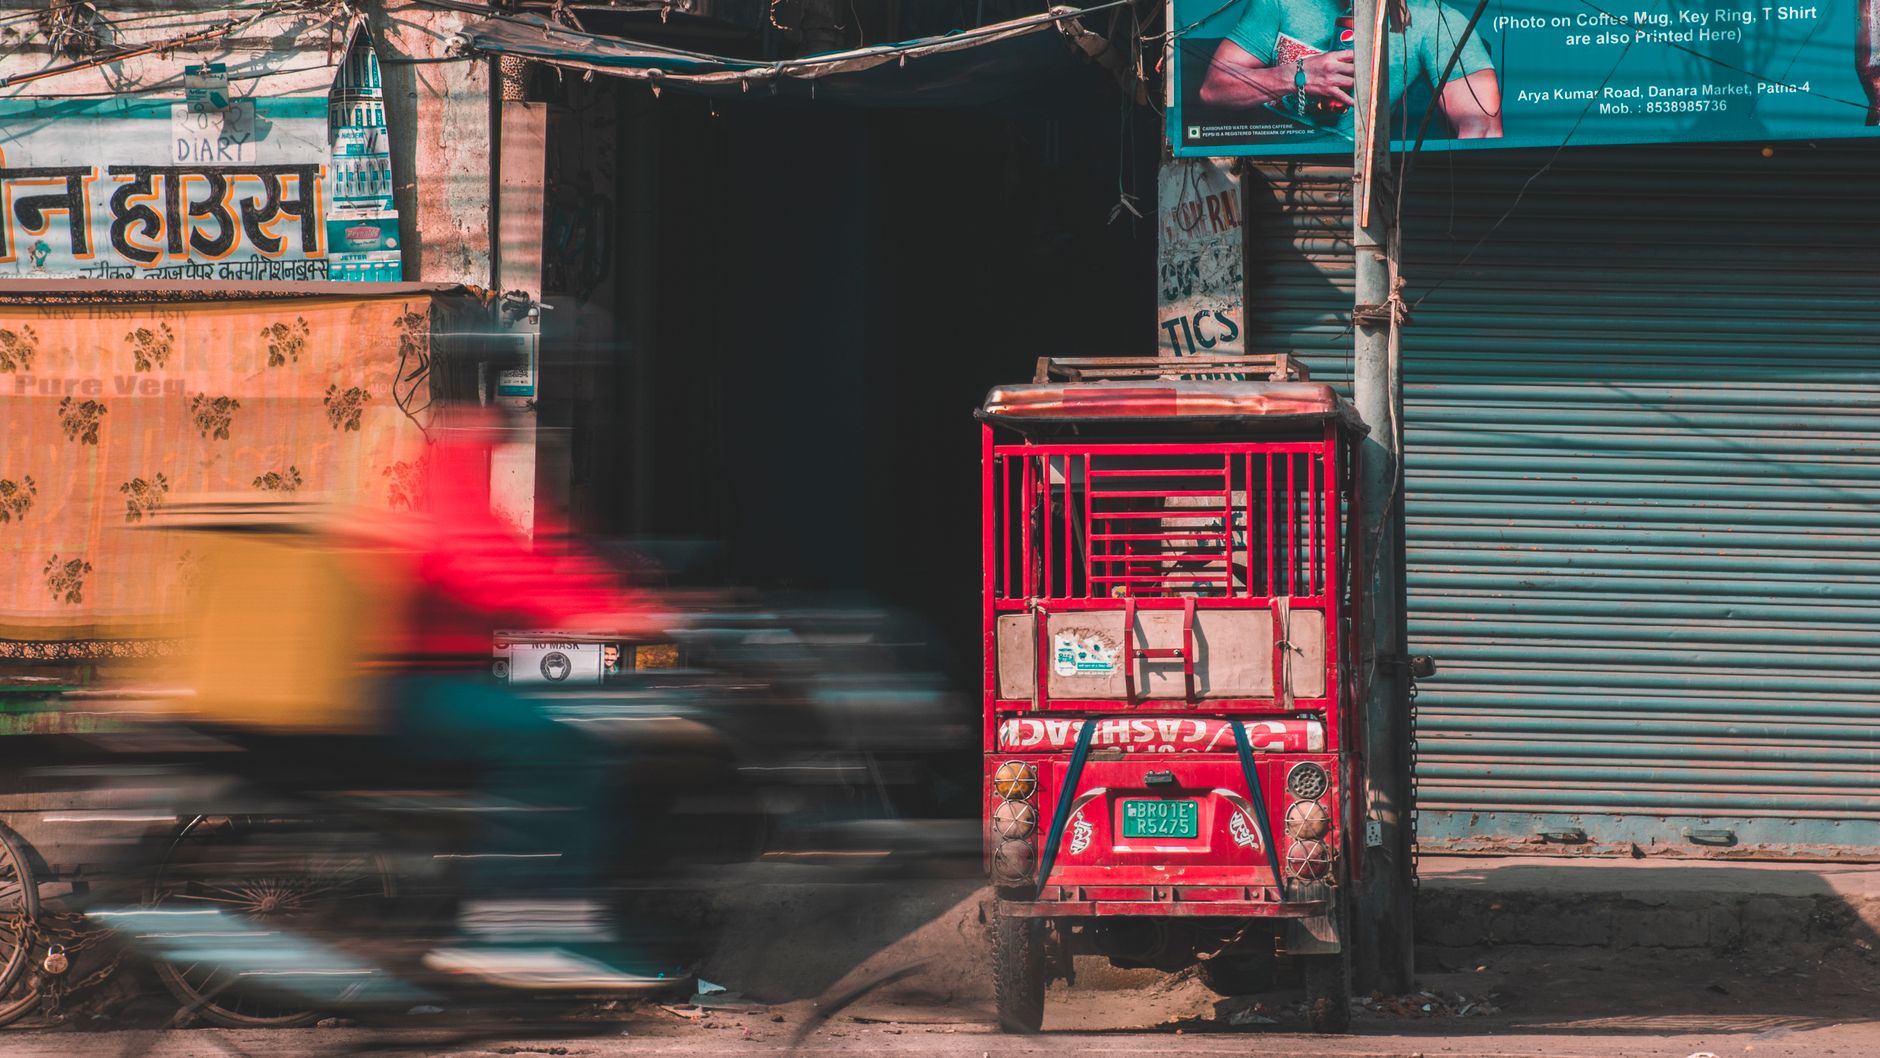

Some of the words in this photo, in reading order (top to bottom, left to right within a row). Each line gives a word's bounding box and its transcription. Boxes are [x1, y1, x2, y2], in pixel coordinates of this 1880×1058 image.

[1493, 15, 1546, 33] (Photo
[1551, 16, 1571, 27] on
[1576, 12, 1629, 27] Coffee
[1634, 11, 1673, 27] Mug,
[1679, 9, 1709, 26] Key
[1715, 8, 1756, 25] Ring,
[1762, 7, 1773, 20] T
[1777, 6, 1817, 20] Shirt
[1566, 34, 1591, 46] are
[1596, 31, 1630, 45] also
[1635, 29, 1693, 43] Printed
[1699, 27, 1742, 44] Here)
[1517, 89, 1549, 103] Arya
[1554, 88, 1599, 100] Kumar
[1603, 86, 1644, 100] Road,
[1649, 85, 1697, 98] Danara
[1702, 83, 1752, 96] Market,
[1757, 81, 1810, 94] Patna-4
[1600, 103, 1633, 114] Mob.
[1646, 101, 1728, 113] 8538985736
[0, 165, 97, 261] न
[108, 163, 325, 265] हाउस
[1161, 309, 1239, 357] TICS
[14, 374, 103, 397] Pure
[114, 374, 194, 397] Veg.
[1137, 802, 1189, 818] BR01E
[1137, 818, 1189, 834] R5475
